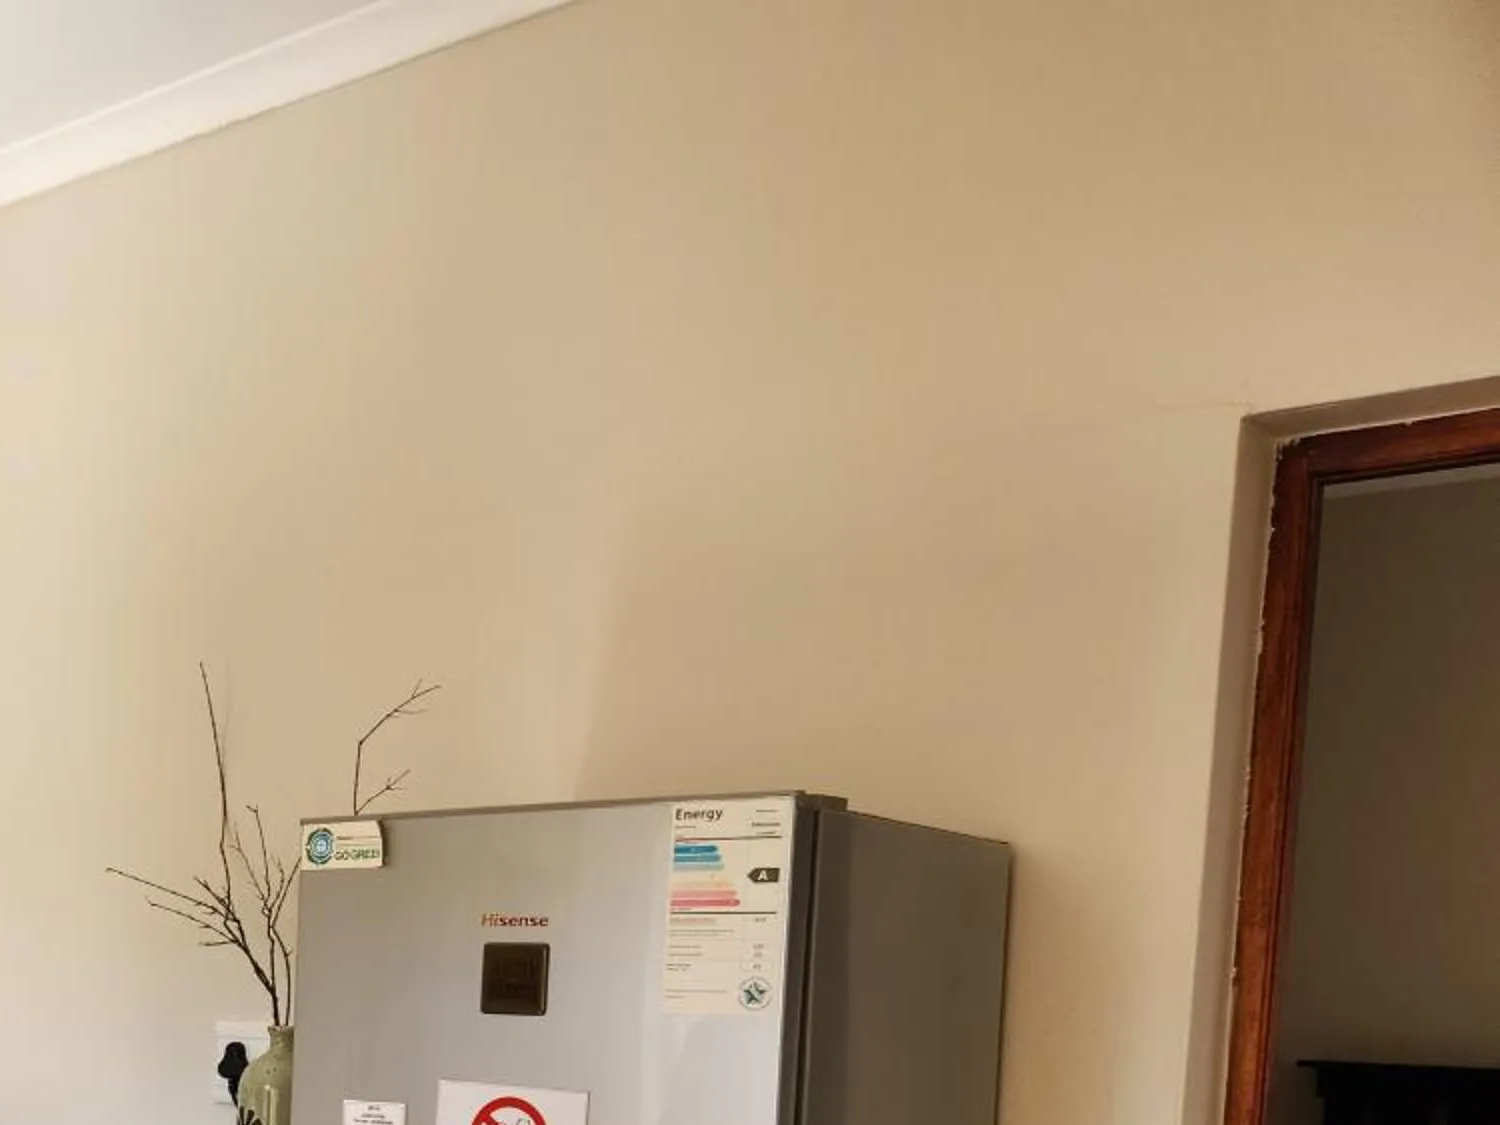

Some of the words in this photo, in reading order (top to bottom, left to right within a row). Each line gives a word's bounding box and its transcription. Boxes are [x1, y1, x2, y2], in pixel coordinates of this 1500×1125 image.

[675, 808, 723, 822] Energy
[757, 869, 769, 881] A
[480, 913, 549, 927] Hisense
